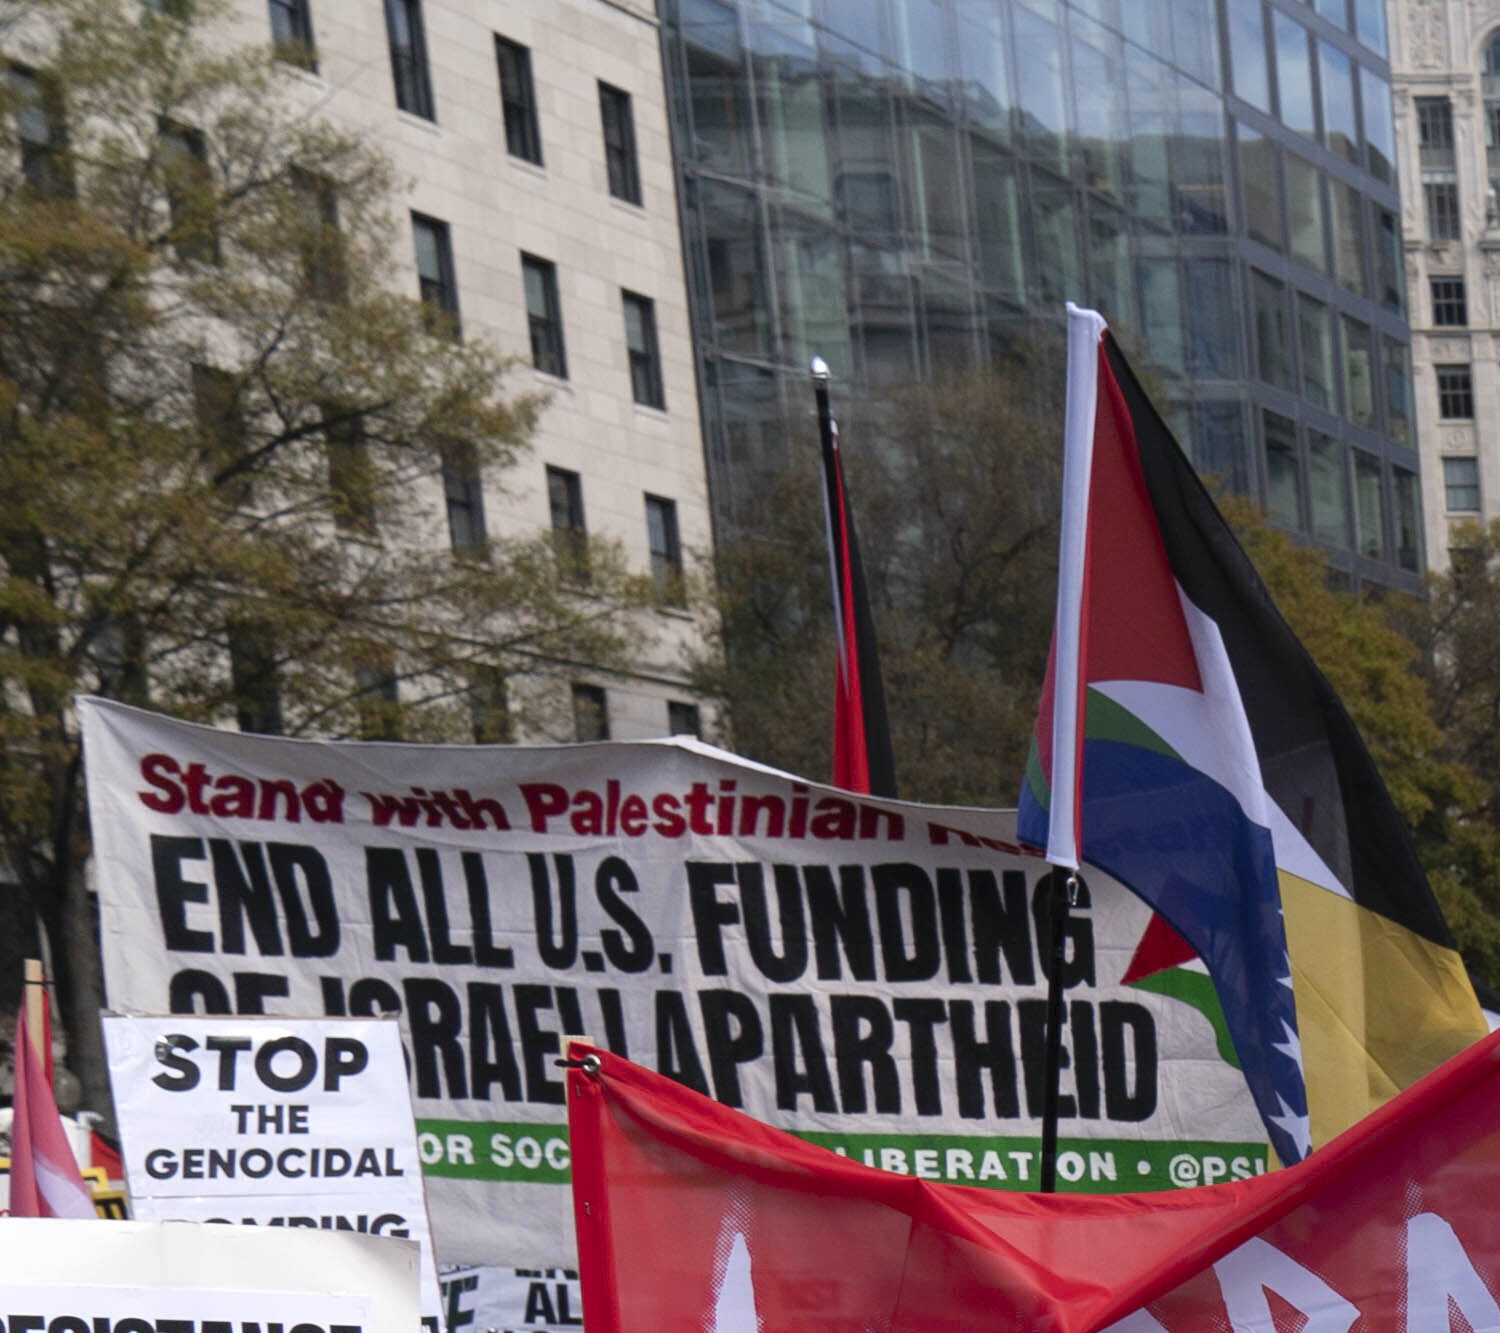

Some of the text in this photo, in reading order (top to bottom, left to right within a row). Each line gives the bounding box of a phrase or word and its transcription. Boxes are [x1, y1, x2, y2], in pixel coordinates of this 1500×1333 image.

[139, 752, 904, 843] Stand with Palestinian
[150, 835, 1092, 988] END ALL U.S. FUNDING
[150, 1036, 368, 1093] STOP
[653, 1000, 1158, 1123] APARTHEID
[231, 1104, 310, 1136] THE
[144, 1145, 405, 1181] GENOCIDAL
